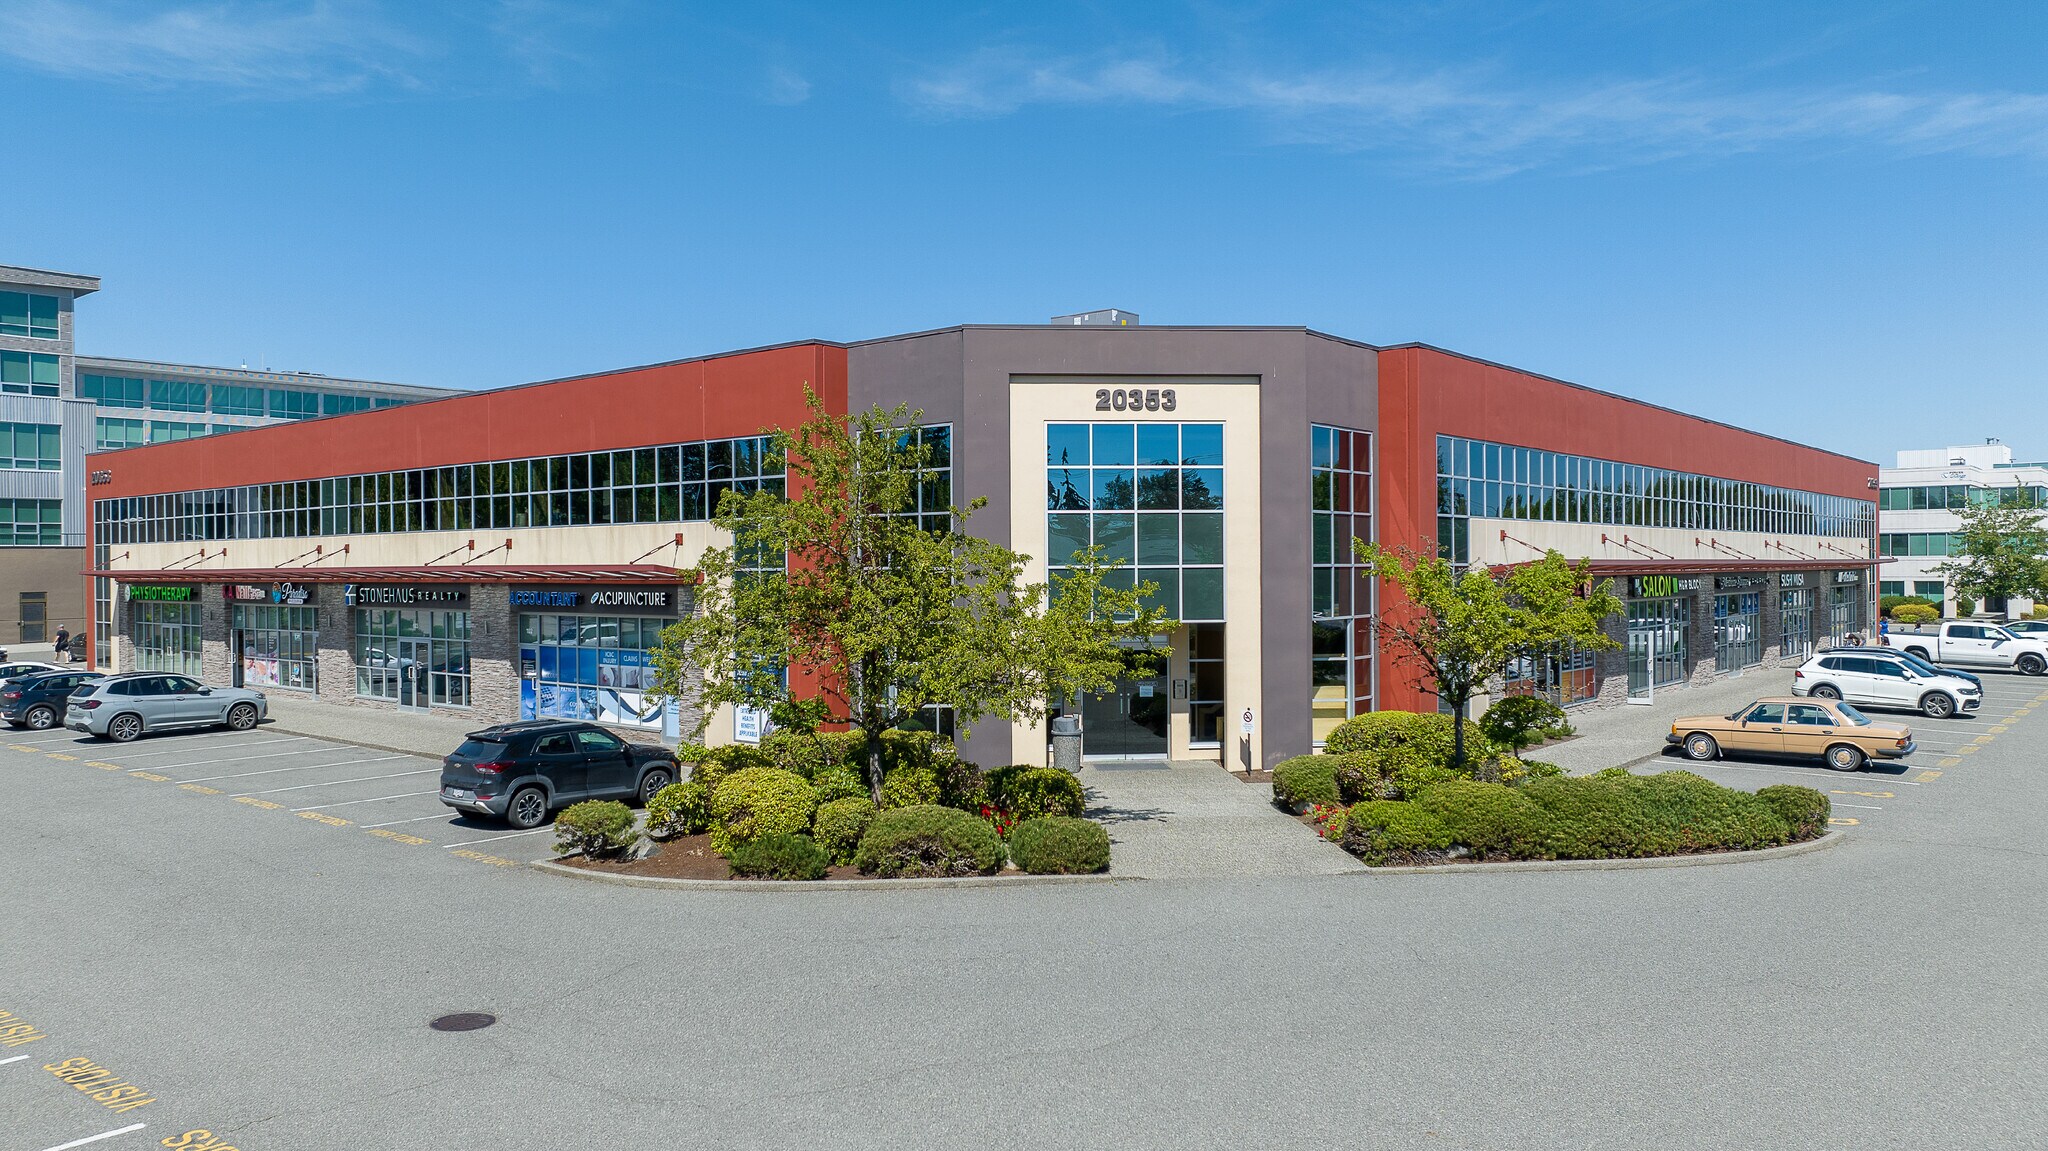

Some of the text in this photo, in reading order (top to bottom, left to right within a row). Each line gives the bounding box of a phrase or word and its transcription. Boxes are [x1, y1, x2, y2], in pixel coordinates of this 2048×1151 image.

[1096, 389, 1177, 411] 20353
[131, 586, 191, 600] PHYSIOTHERAPY
[1643, 576, 1671, 597] SALON
[360, 588, 460, 603] STONEHAUS REALTY
[510, 591, 577, 606] ACCOUNTANT
[599, 592, 666, 606] ACUPUNCTURE
[43, 1057, 157, 1114] VISITORS
